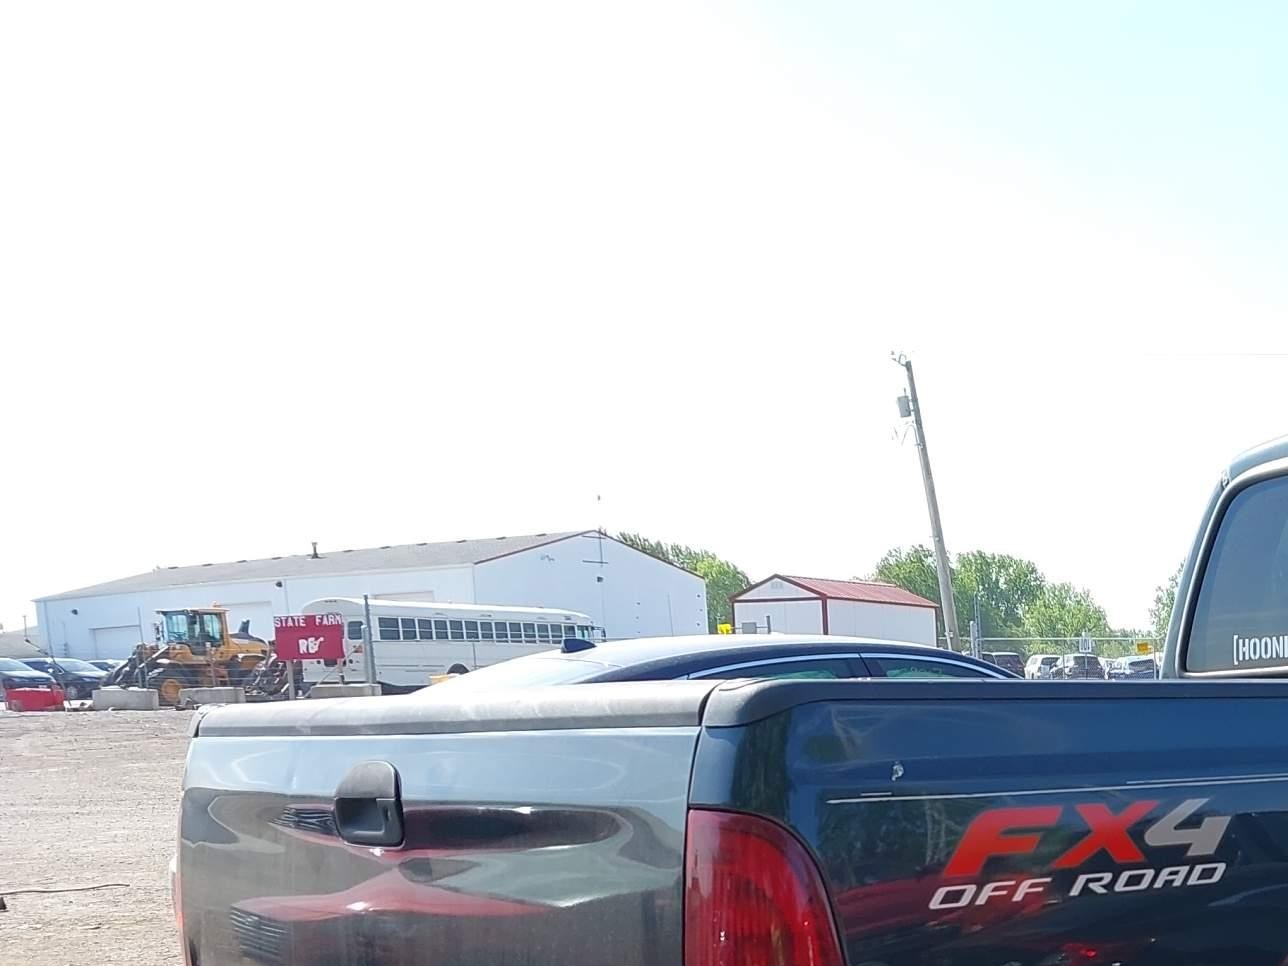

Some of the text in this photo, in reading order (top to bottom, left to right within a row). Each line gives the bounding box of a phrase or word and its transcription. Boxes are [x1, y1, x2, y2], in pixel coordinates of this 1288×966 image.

[274, 615, 307, 628] STATE
[943, 798, 1232, 878] FX4
[929, 862, 1228, 910] OFF ROAD
